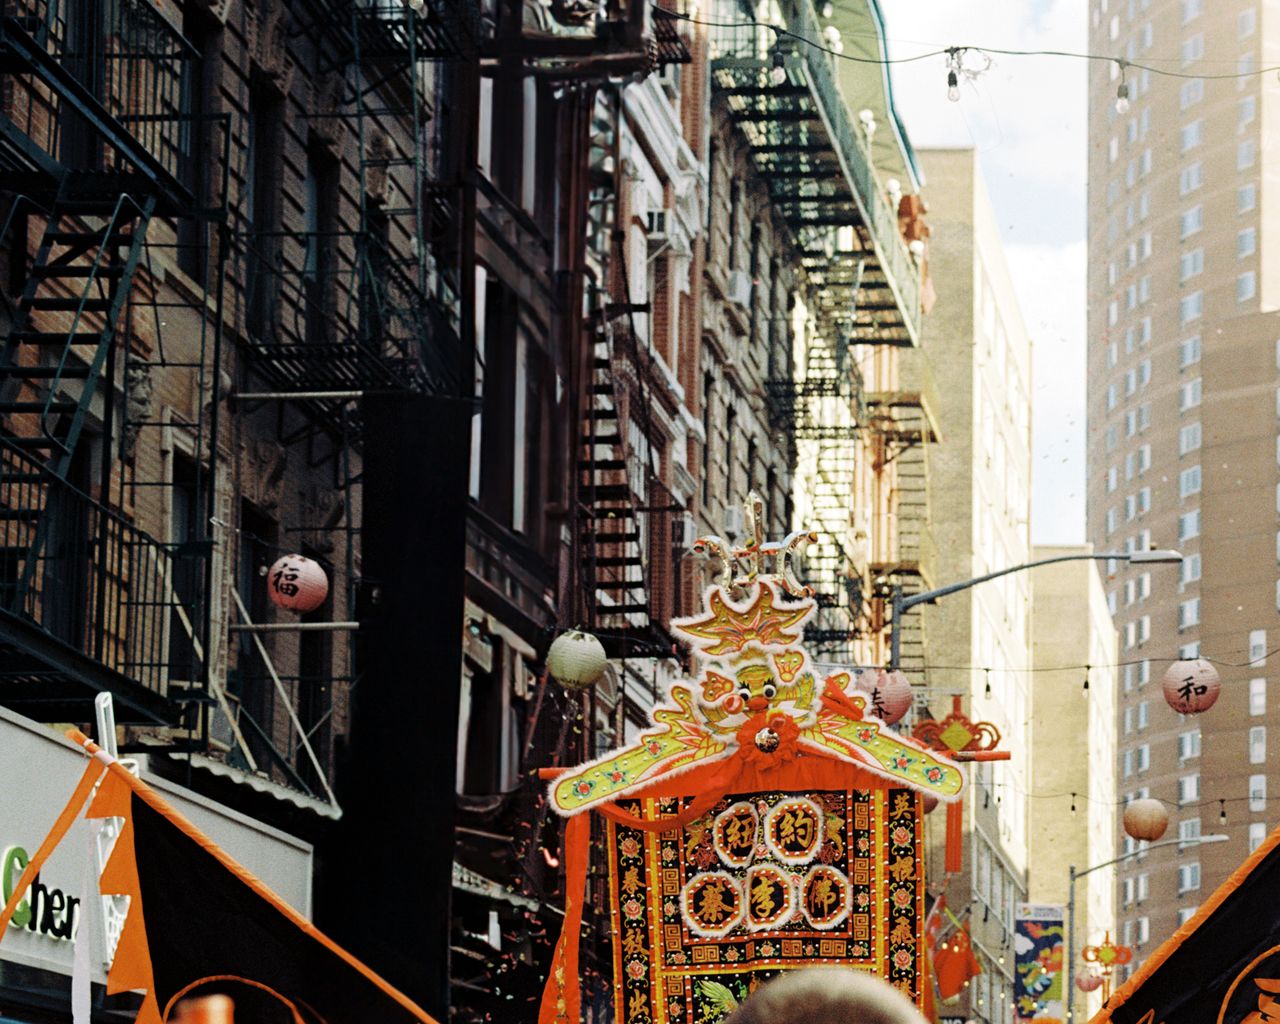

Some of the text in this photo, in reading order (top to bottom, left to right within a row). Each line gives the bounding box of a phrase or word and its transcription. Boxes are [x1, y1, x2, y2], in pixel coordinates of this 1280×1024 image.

[273, 563, 300, 597] 福
[1177, 675, 1208, 704] 和
[725, 810, 814, 849] 紐約
[699, 875, 837, 922] 蔡李佛
